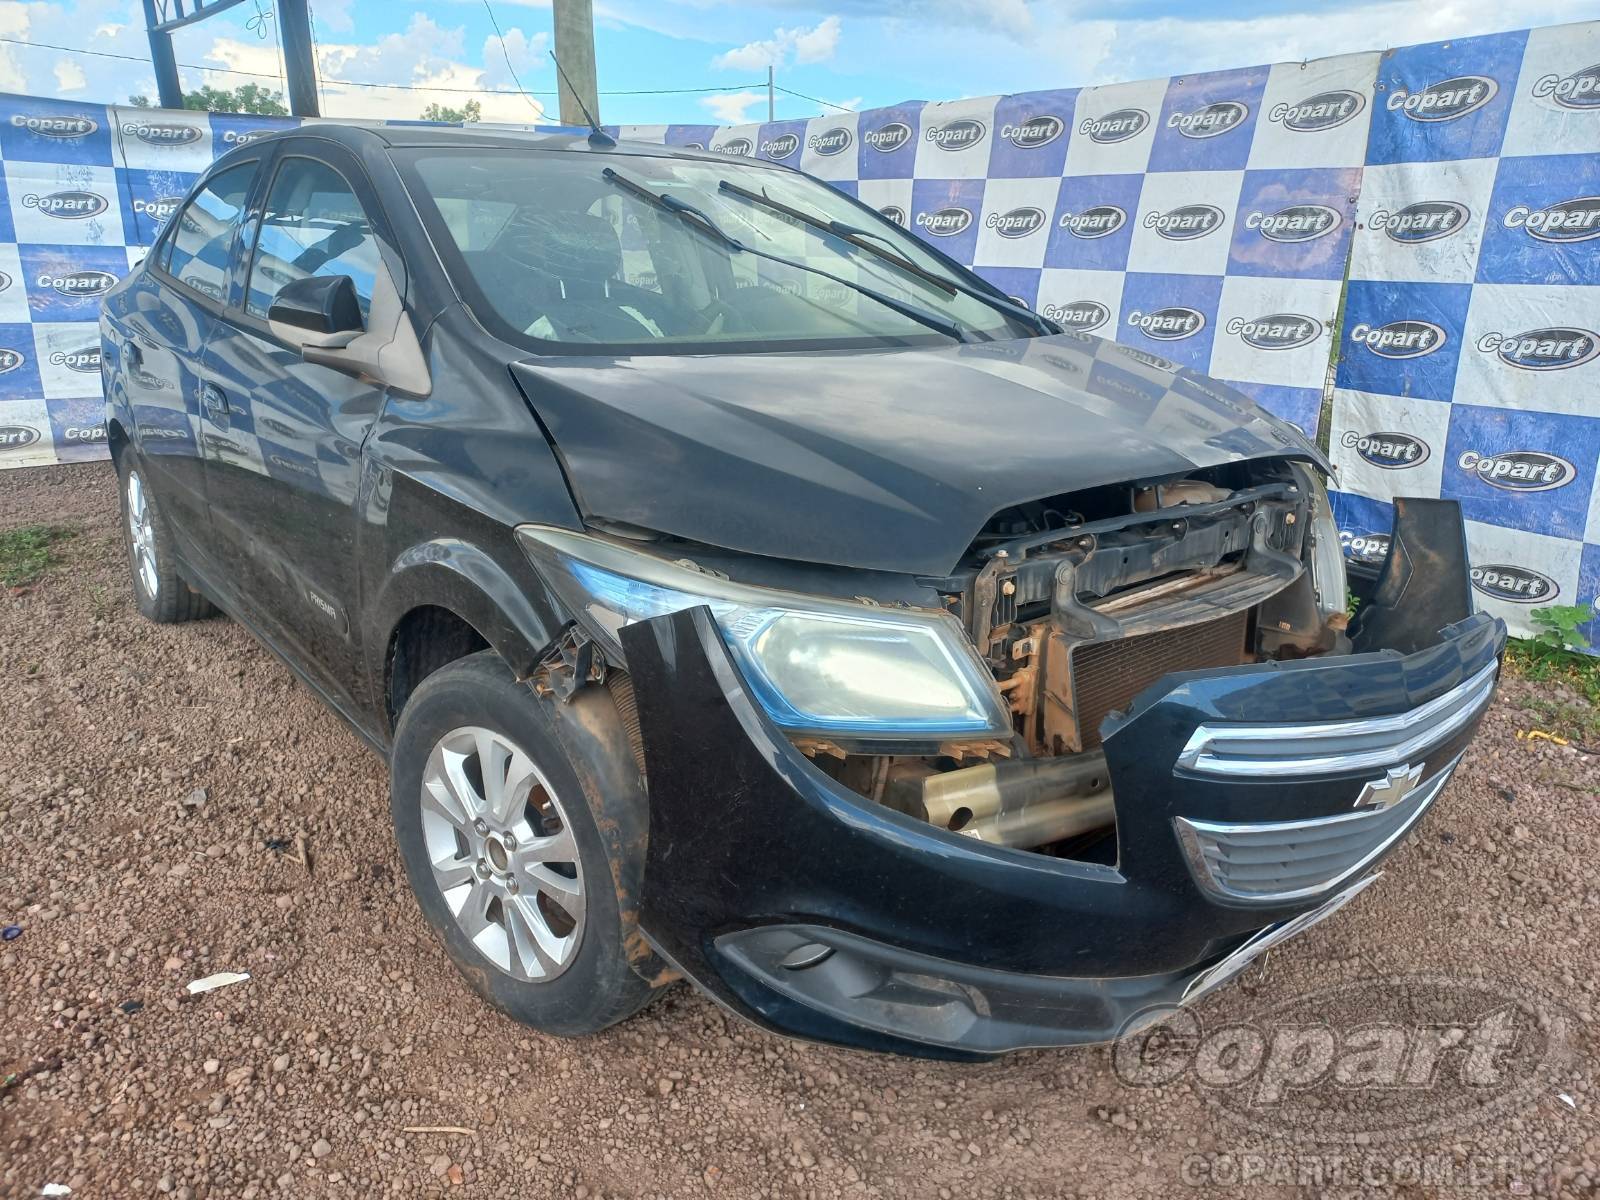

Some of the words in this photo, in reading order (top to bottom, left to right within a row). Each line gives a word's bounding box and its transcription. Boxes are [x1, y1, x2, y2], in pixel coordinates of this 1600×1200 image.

[1386, 81, 1483, 113] Copart
[1531, 73, 1600, 100] Cop
[1168, 108, 1236, 133] Copart
[1269, 98, 1350, 127] Copart
[11, 115, 88, 136] Copart
[123, 123, 191, 141] Copart
[864, 128, 904, 145] Copart
[926, 125, 977, 143] Copart
[1001, 118, 1054, 142] Copart
[1080, 113, 1140, 138] Copart
[761, 138, 794, 155] Copart
[809, 132, 845, 149] Copart
[22, 193, 96, 212] Copart
[134, 200, 177, 216] Copa
[916, 210, 965, 229] Copart
[986, 210, 1039, 232] Copart
[1059, 207, 1120, 233] Copart
[1143, 209, 1212, 235] Copart
[1245, 210, 1328, 235] Copart
[1368, 207, 1457, 231] Copart
[1503, 206, 1600, 233] Copar
[37, 275, 108, 291] Copart
[1043, 304, 1102, 326] Copart
[1127, 310, 1196, 333] Copart
[1226, 317, 1312, 341] Copart
[1350, 324, 1434, 350] Copart
[1477, 331, 1588, 358] Copart
[50, 352, 101, 366] Copa
[0, 430, 27, 442] art
[65, 428, 103, 440] Cop
[1341, 431, 1417, 460] Copart
[1458, 450, 1560, 482] Copart
[1339, 530, 1389, 555] Copa
[1470, 566, 1543, 595] opart
[310, 591, 336, 620] PRISMA
